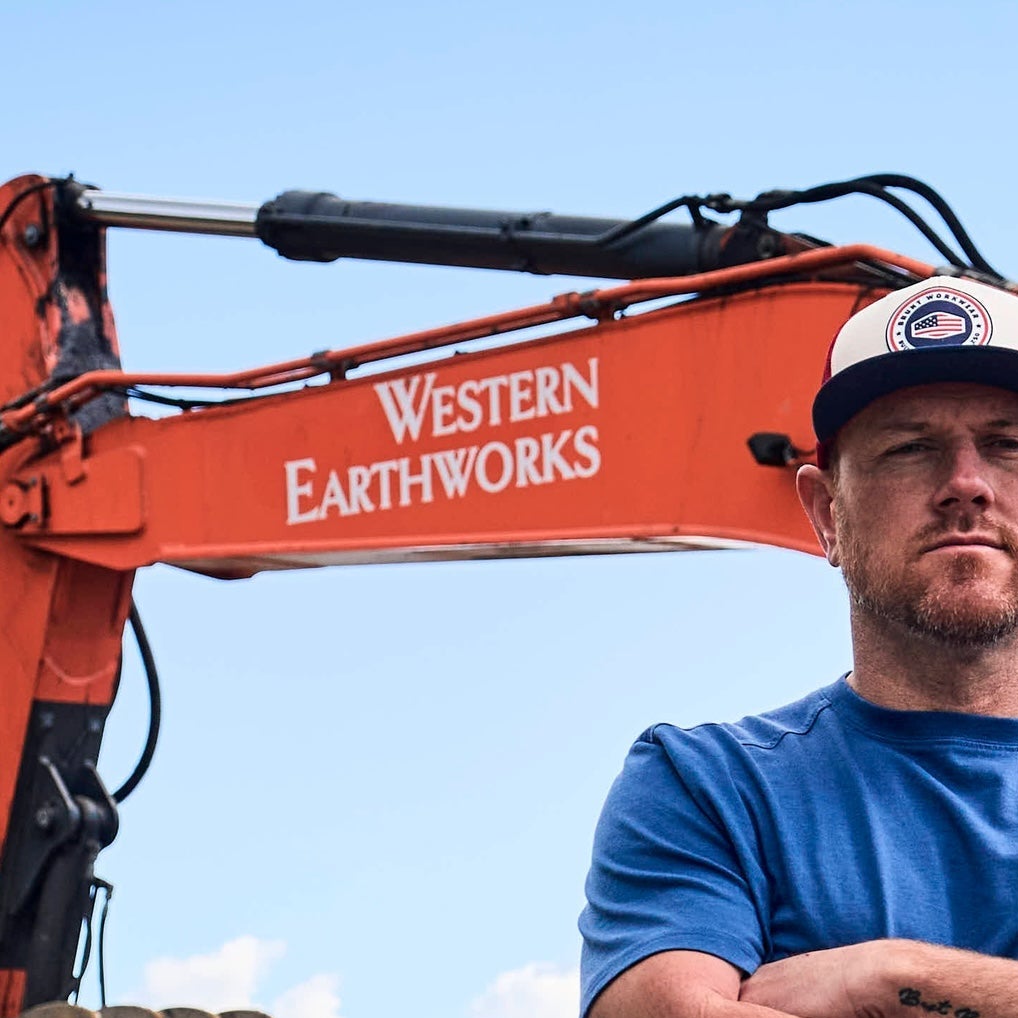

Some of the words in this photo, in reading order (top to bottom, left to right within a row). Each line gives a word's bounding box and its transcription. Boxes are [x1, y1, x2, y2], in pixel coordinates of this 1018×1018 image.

[897, 300, 922, 326] BRUNT
[926, 293, 980, 319] WORKWEAR
[374, 358, 599, 444] WESTERN
[284, 425, 601, 525] EARTHWORKS
